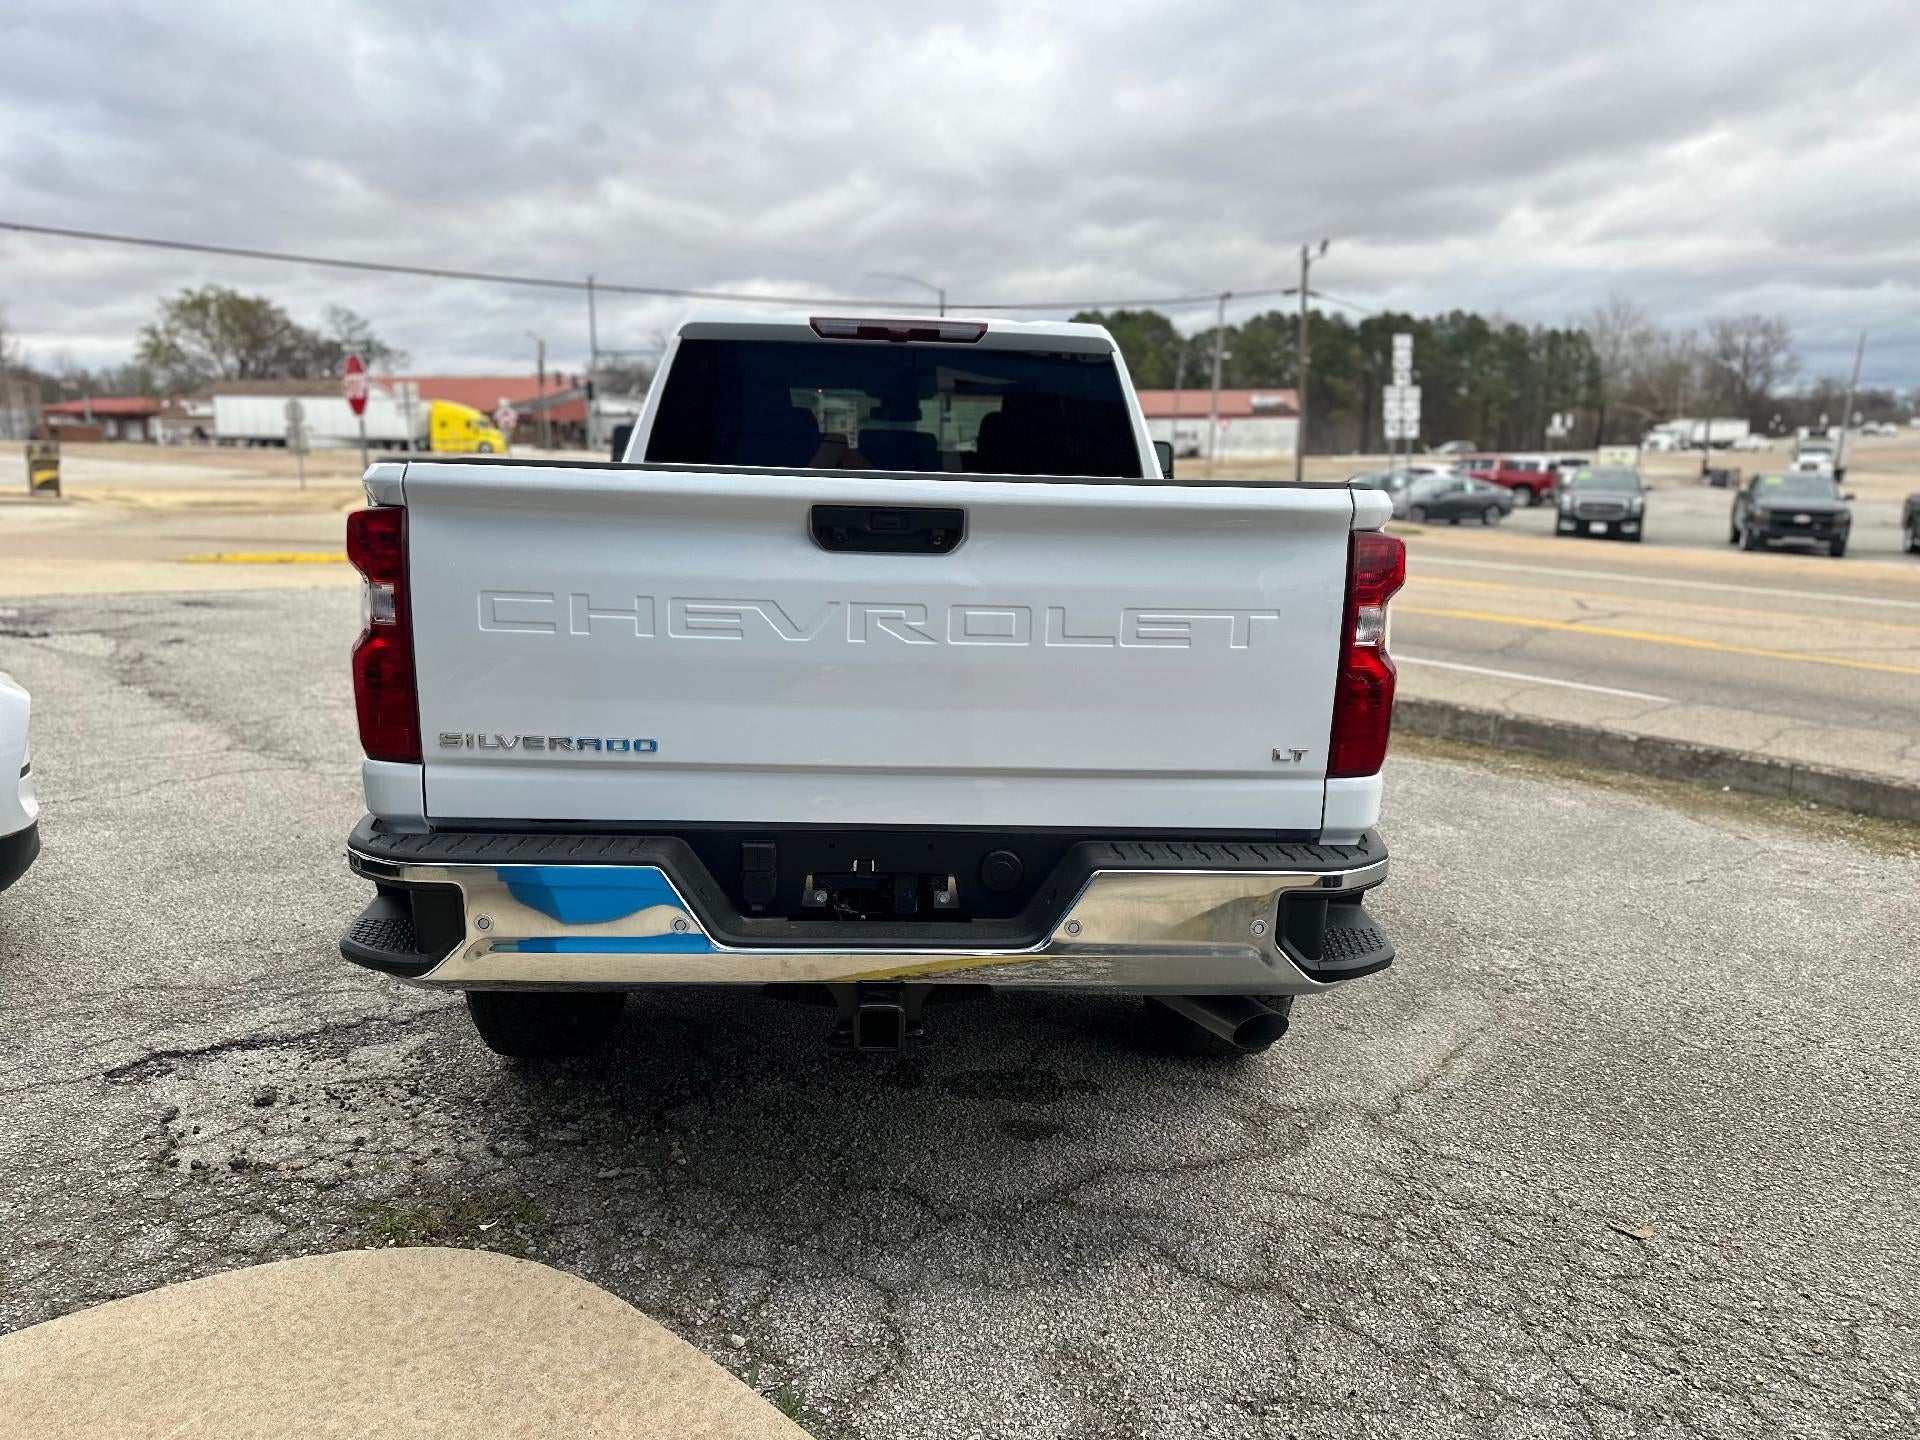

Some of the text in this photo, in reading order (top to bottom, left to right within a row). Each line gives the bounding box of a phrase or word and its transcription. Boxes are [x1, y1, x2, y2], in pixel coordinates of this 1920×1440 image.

[477, 589, 1281, 649] CHEVROLET
[438, 731, 659, 753] SILVERADO
[1271, 747, 1311, 761] LT
